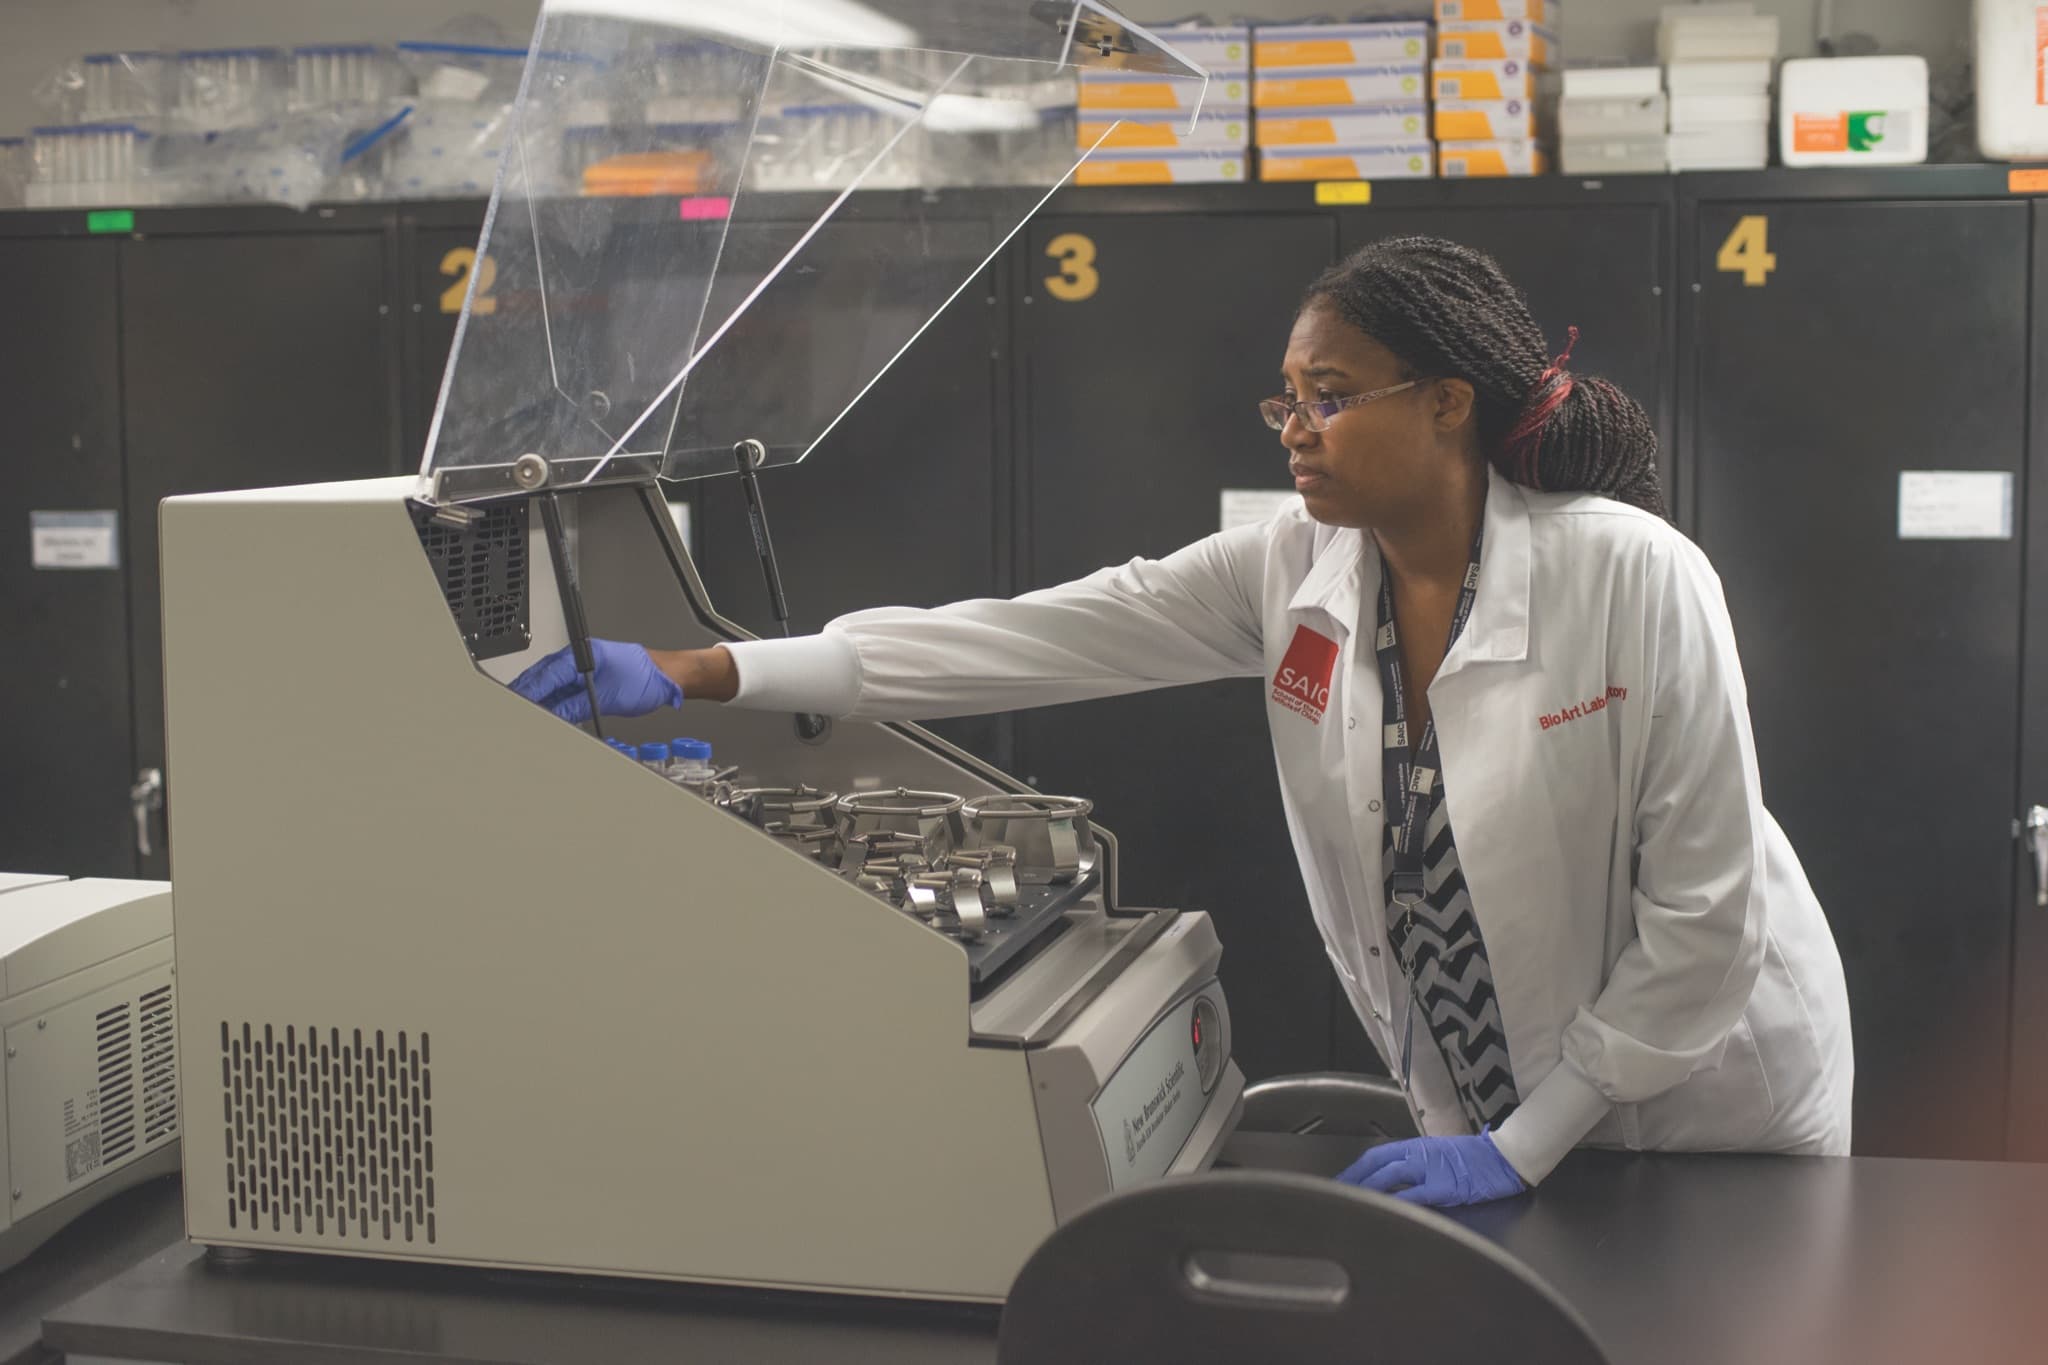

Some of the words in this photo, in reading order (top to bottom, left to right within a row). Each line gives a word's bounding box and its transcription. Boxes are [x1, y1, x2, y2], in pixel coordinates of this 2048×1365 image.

[1044, 232, 1098, 301] 3
[1716, 215, 1776, 287] 4
[439, 246, 497, 315] 2
[1466, 564, 1480, 588] SAIC
[1278, 667, 1329, 706] SAIC
[1397, 722, 1406, 746] SAIC
[1411, 767, 1423, 791] SAIC
[1132, 1115, 1144, 1132] New
